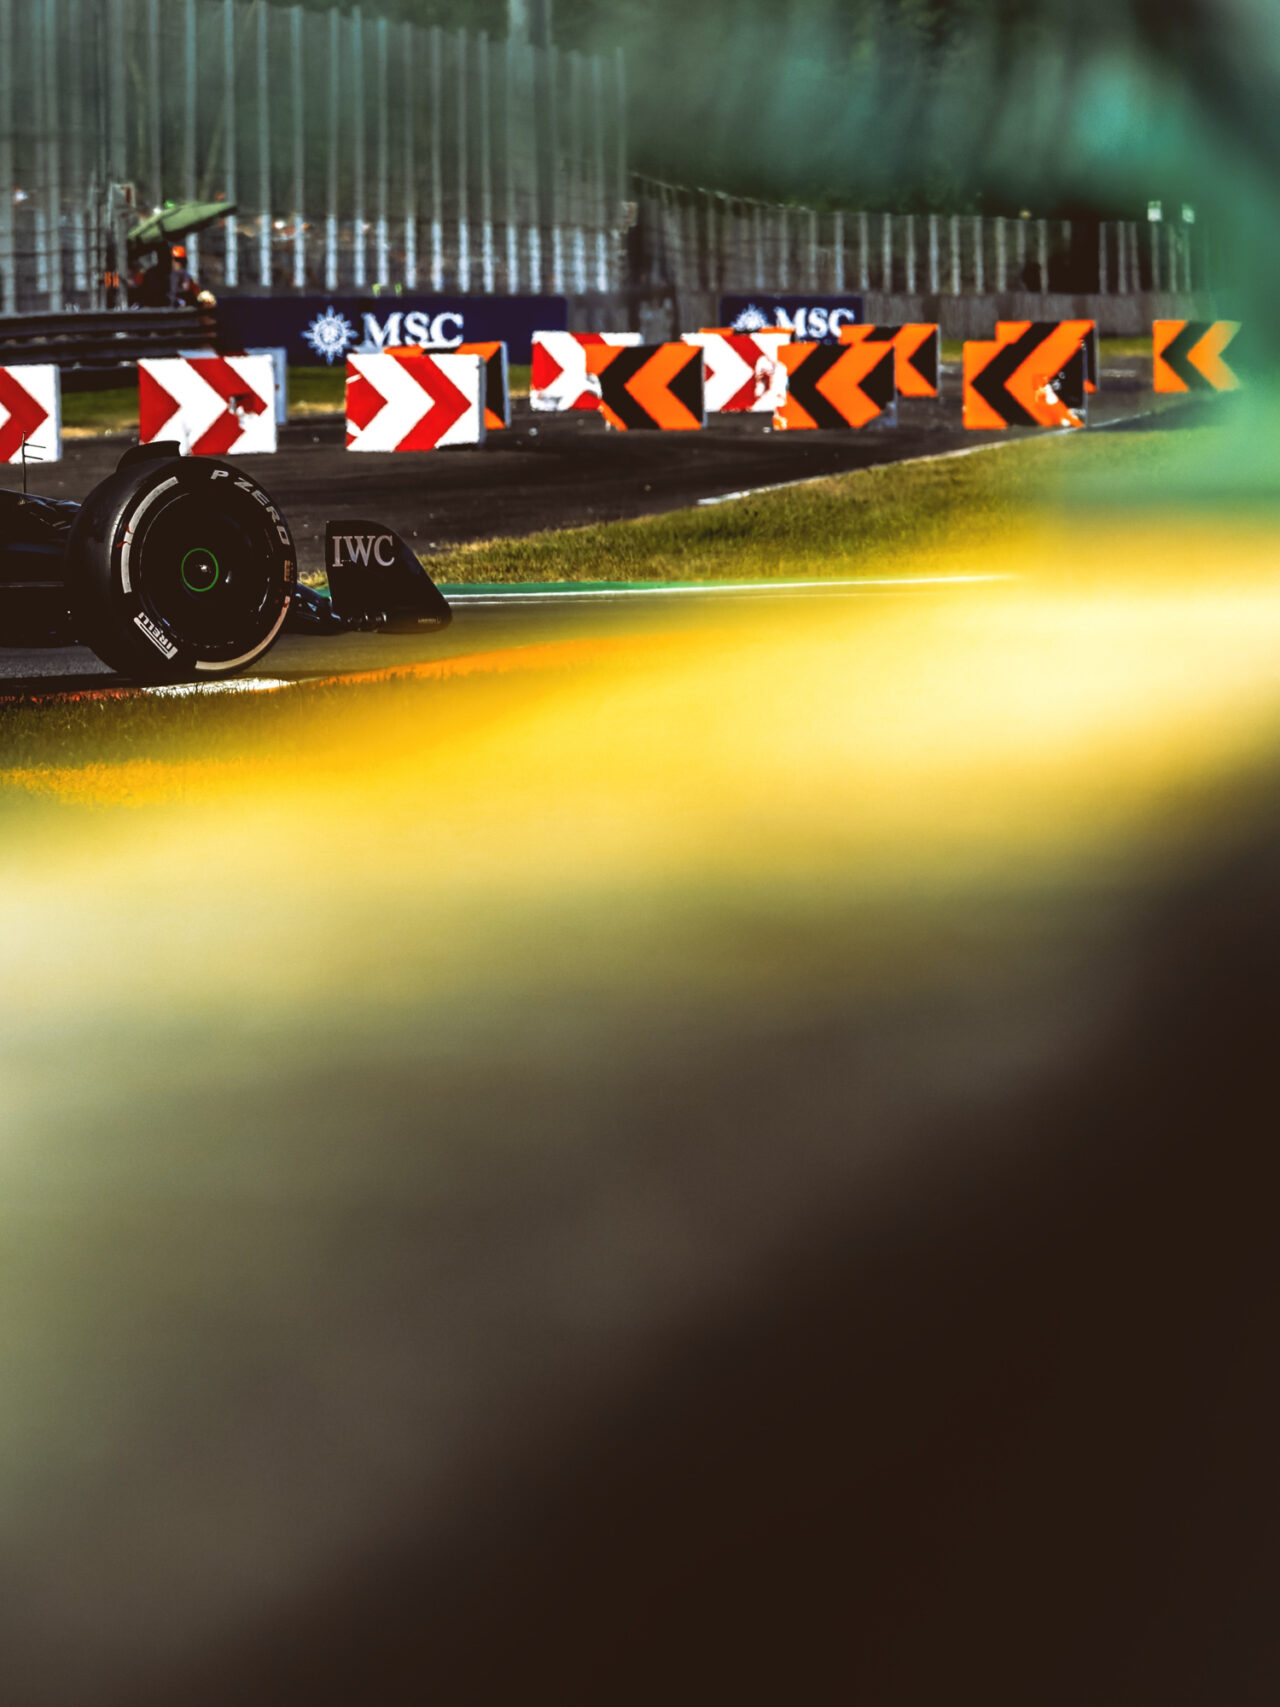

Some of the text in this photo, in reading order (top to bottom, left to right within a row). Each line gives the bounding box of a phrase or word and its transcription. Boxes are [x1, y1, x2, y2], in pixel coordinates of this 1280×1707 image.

[357, 311, 464, 349] MSC
[773, 306, 855, 339] MSC
[210, 469, 290, 545] P ZERO
[332, 535, 395, 567] IWC
[133, 611, 178, 660] PIRELLI
